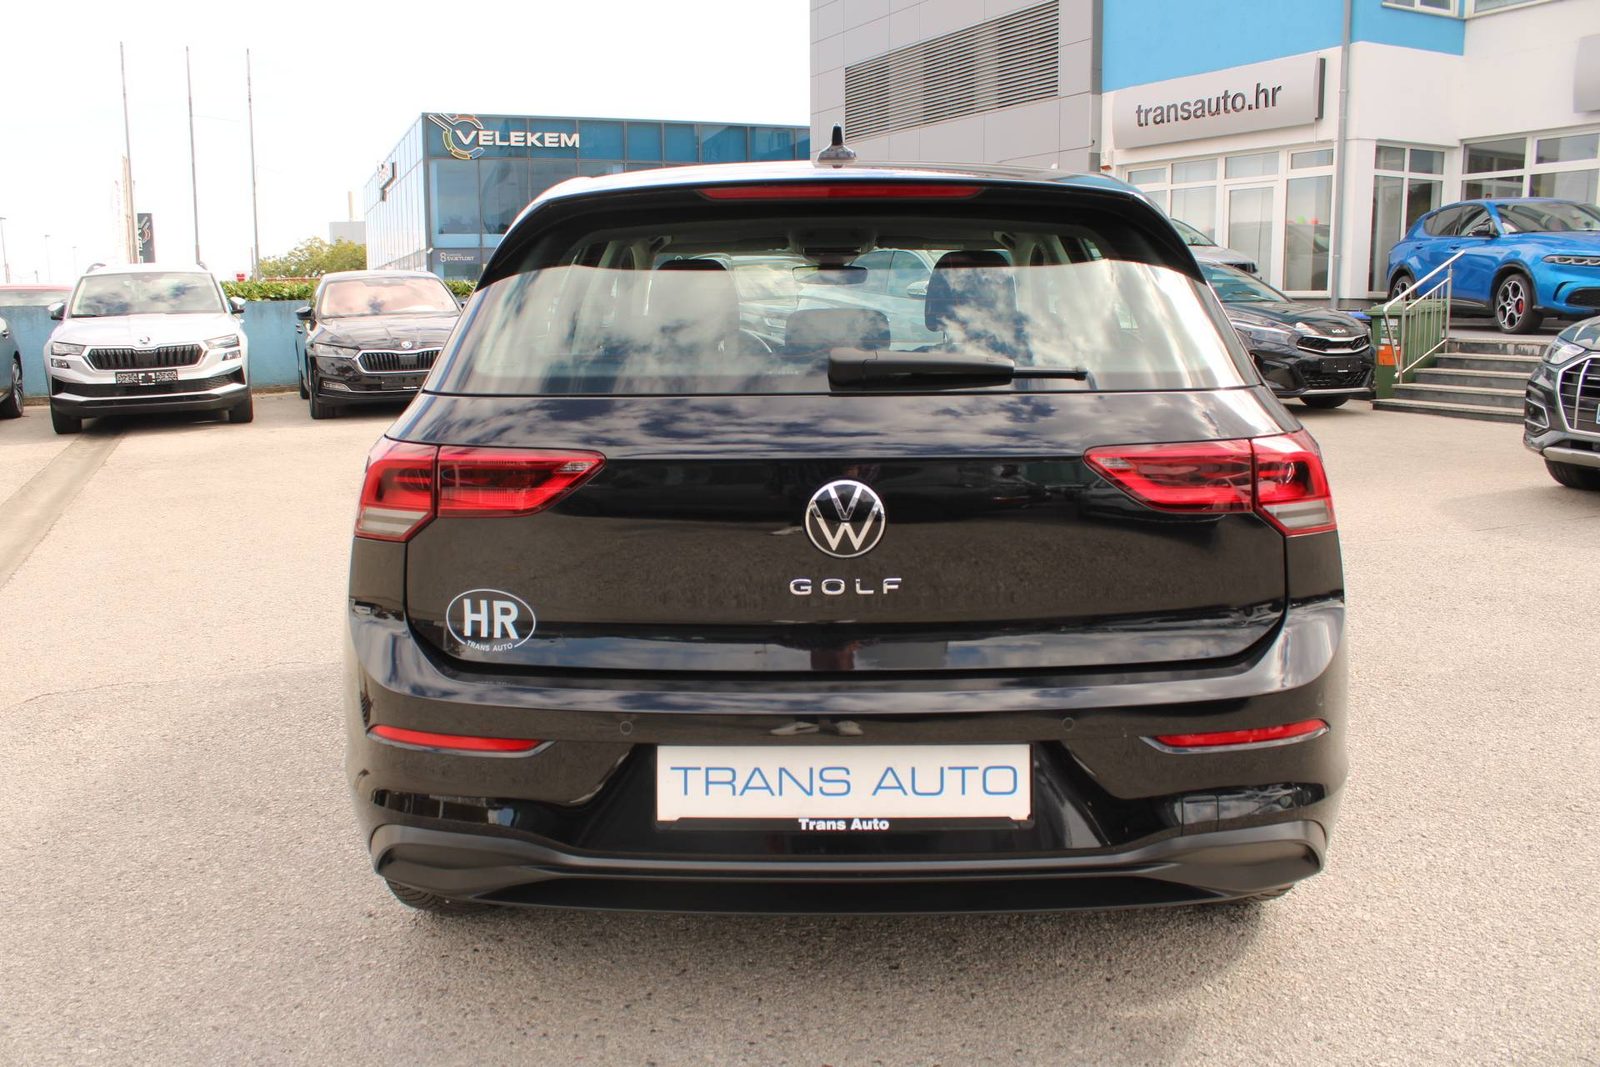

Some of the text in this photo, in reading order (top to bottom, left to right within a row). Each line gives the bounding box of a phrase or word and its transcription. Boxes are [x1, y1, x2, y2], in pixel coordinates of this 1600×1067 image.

[1135, 82, 1282, 127] transauto.hr
[455, 129, 580, 148] VELEKEM
[789, 577, 902, 595] GOLF
[463, 598, 519, 639] HR
[467, 640, 513, 652] TRANS AUTO
[670, 766, 1018, 796] TRANS AUTO
[798, 818, 890, 831] Trans Auto
